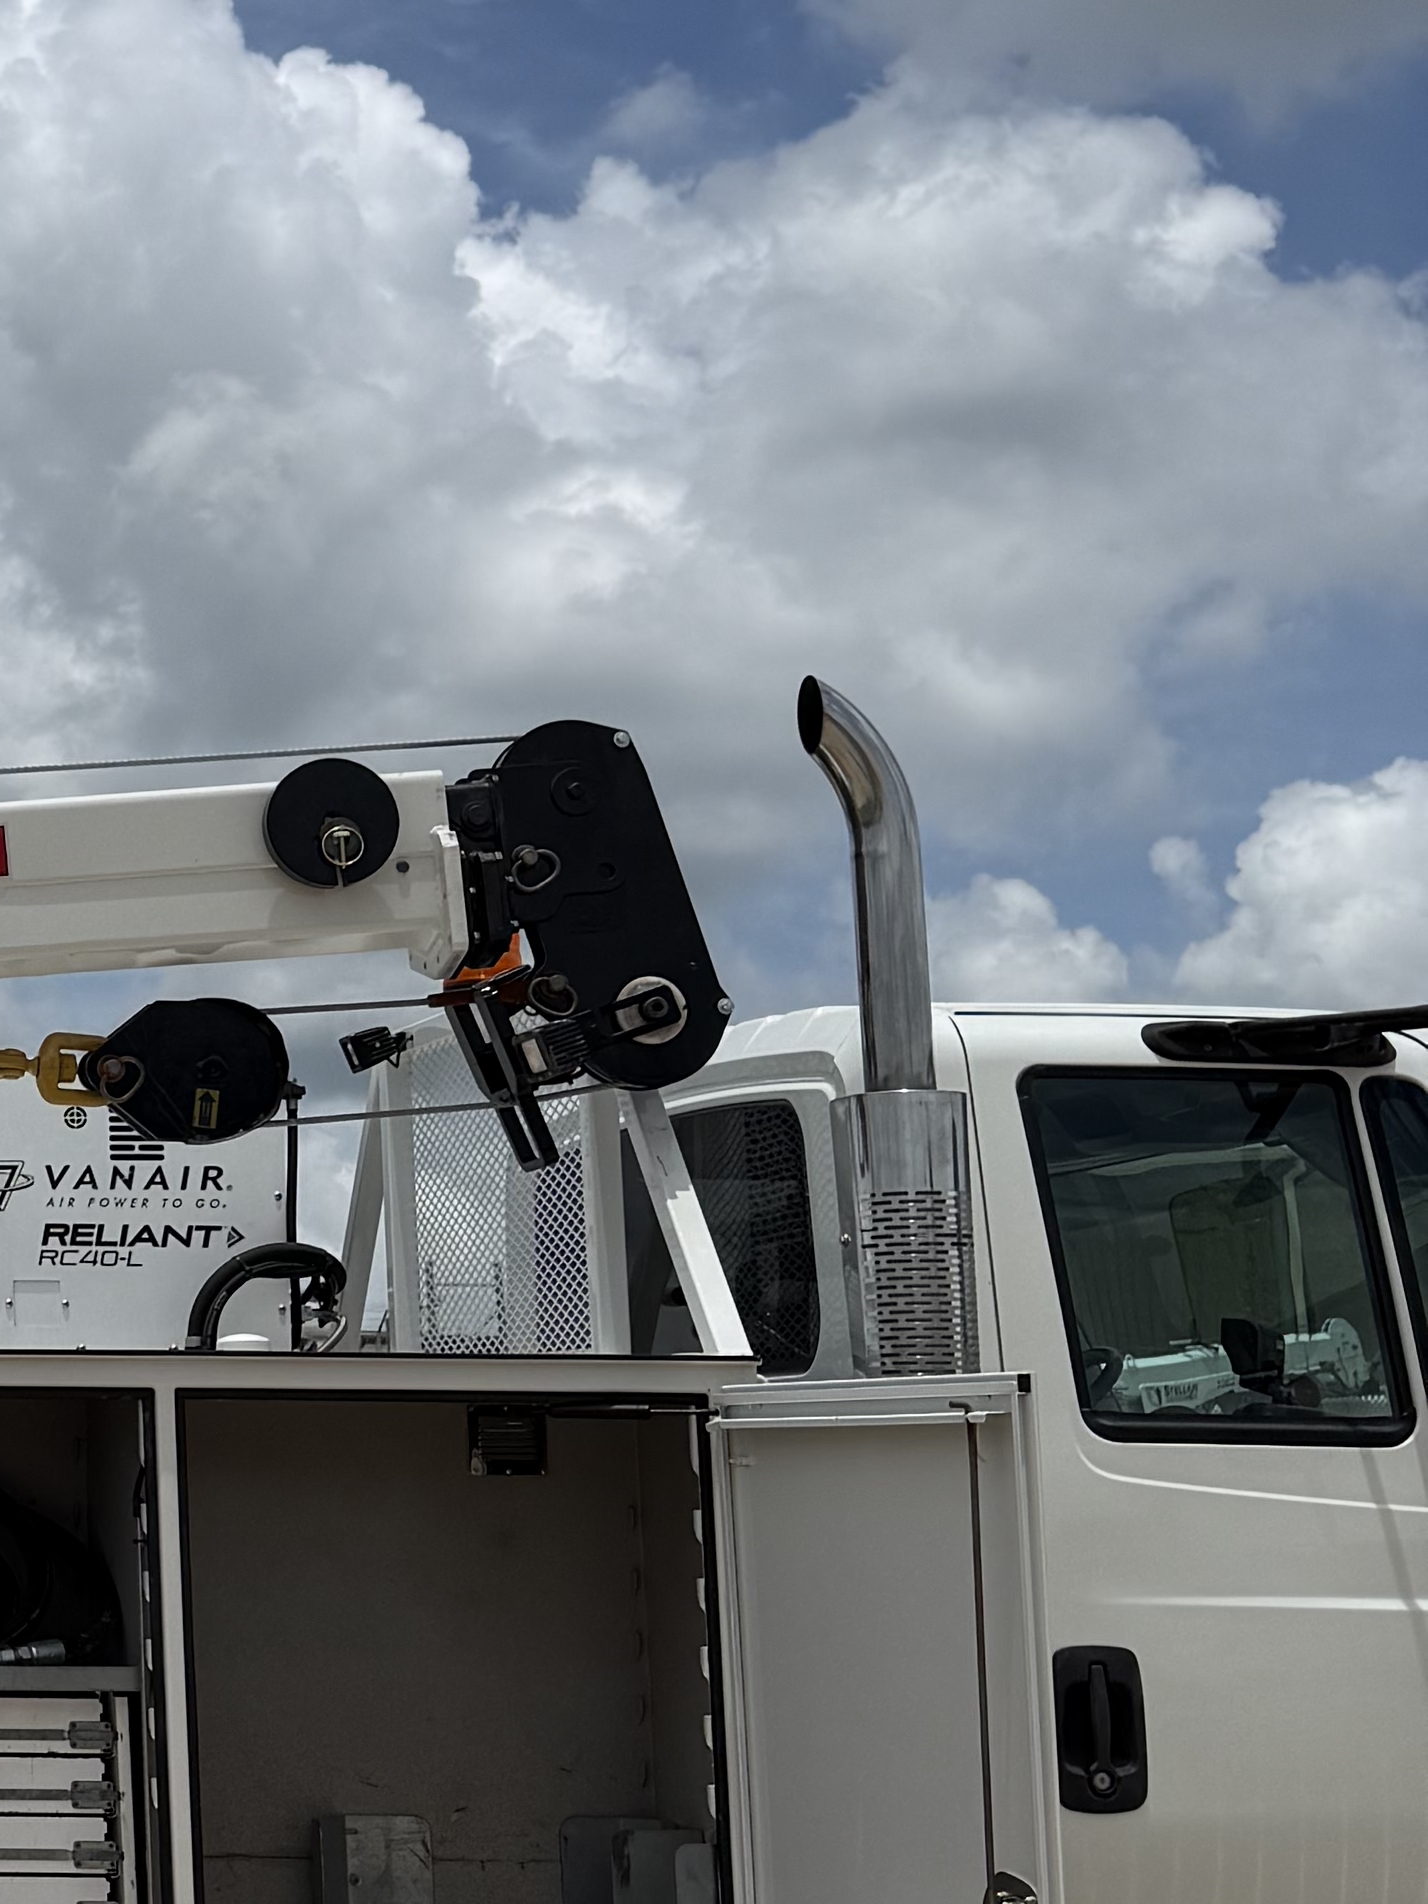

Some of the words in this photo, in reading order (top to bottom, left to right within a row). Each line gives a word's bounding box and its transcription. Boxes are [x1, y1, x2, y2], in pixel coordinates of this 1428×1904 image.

[45, 1164, 224, 1191] VANAIR
[46, 1197, 76, 1208] AIR
[87, 1197, 150, 1208] POWER
[162, 1198, 183, 1208] TO
[195, 1198, 228, 1208] GO.
[41, 1222, 223, 1248] RELIANT
[38, 1249, 144, 1267] RC40-L
